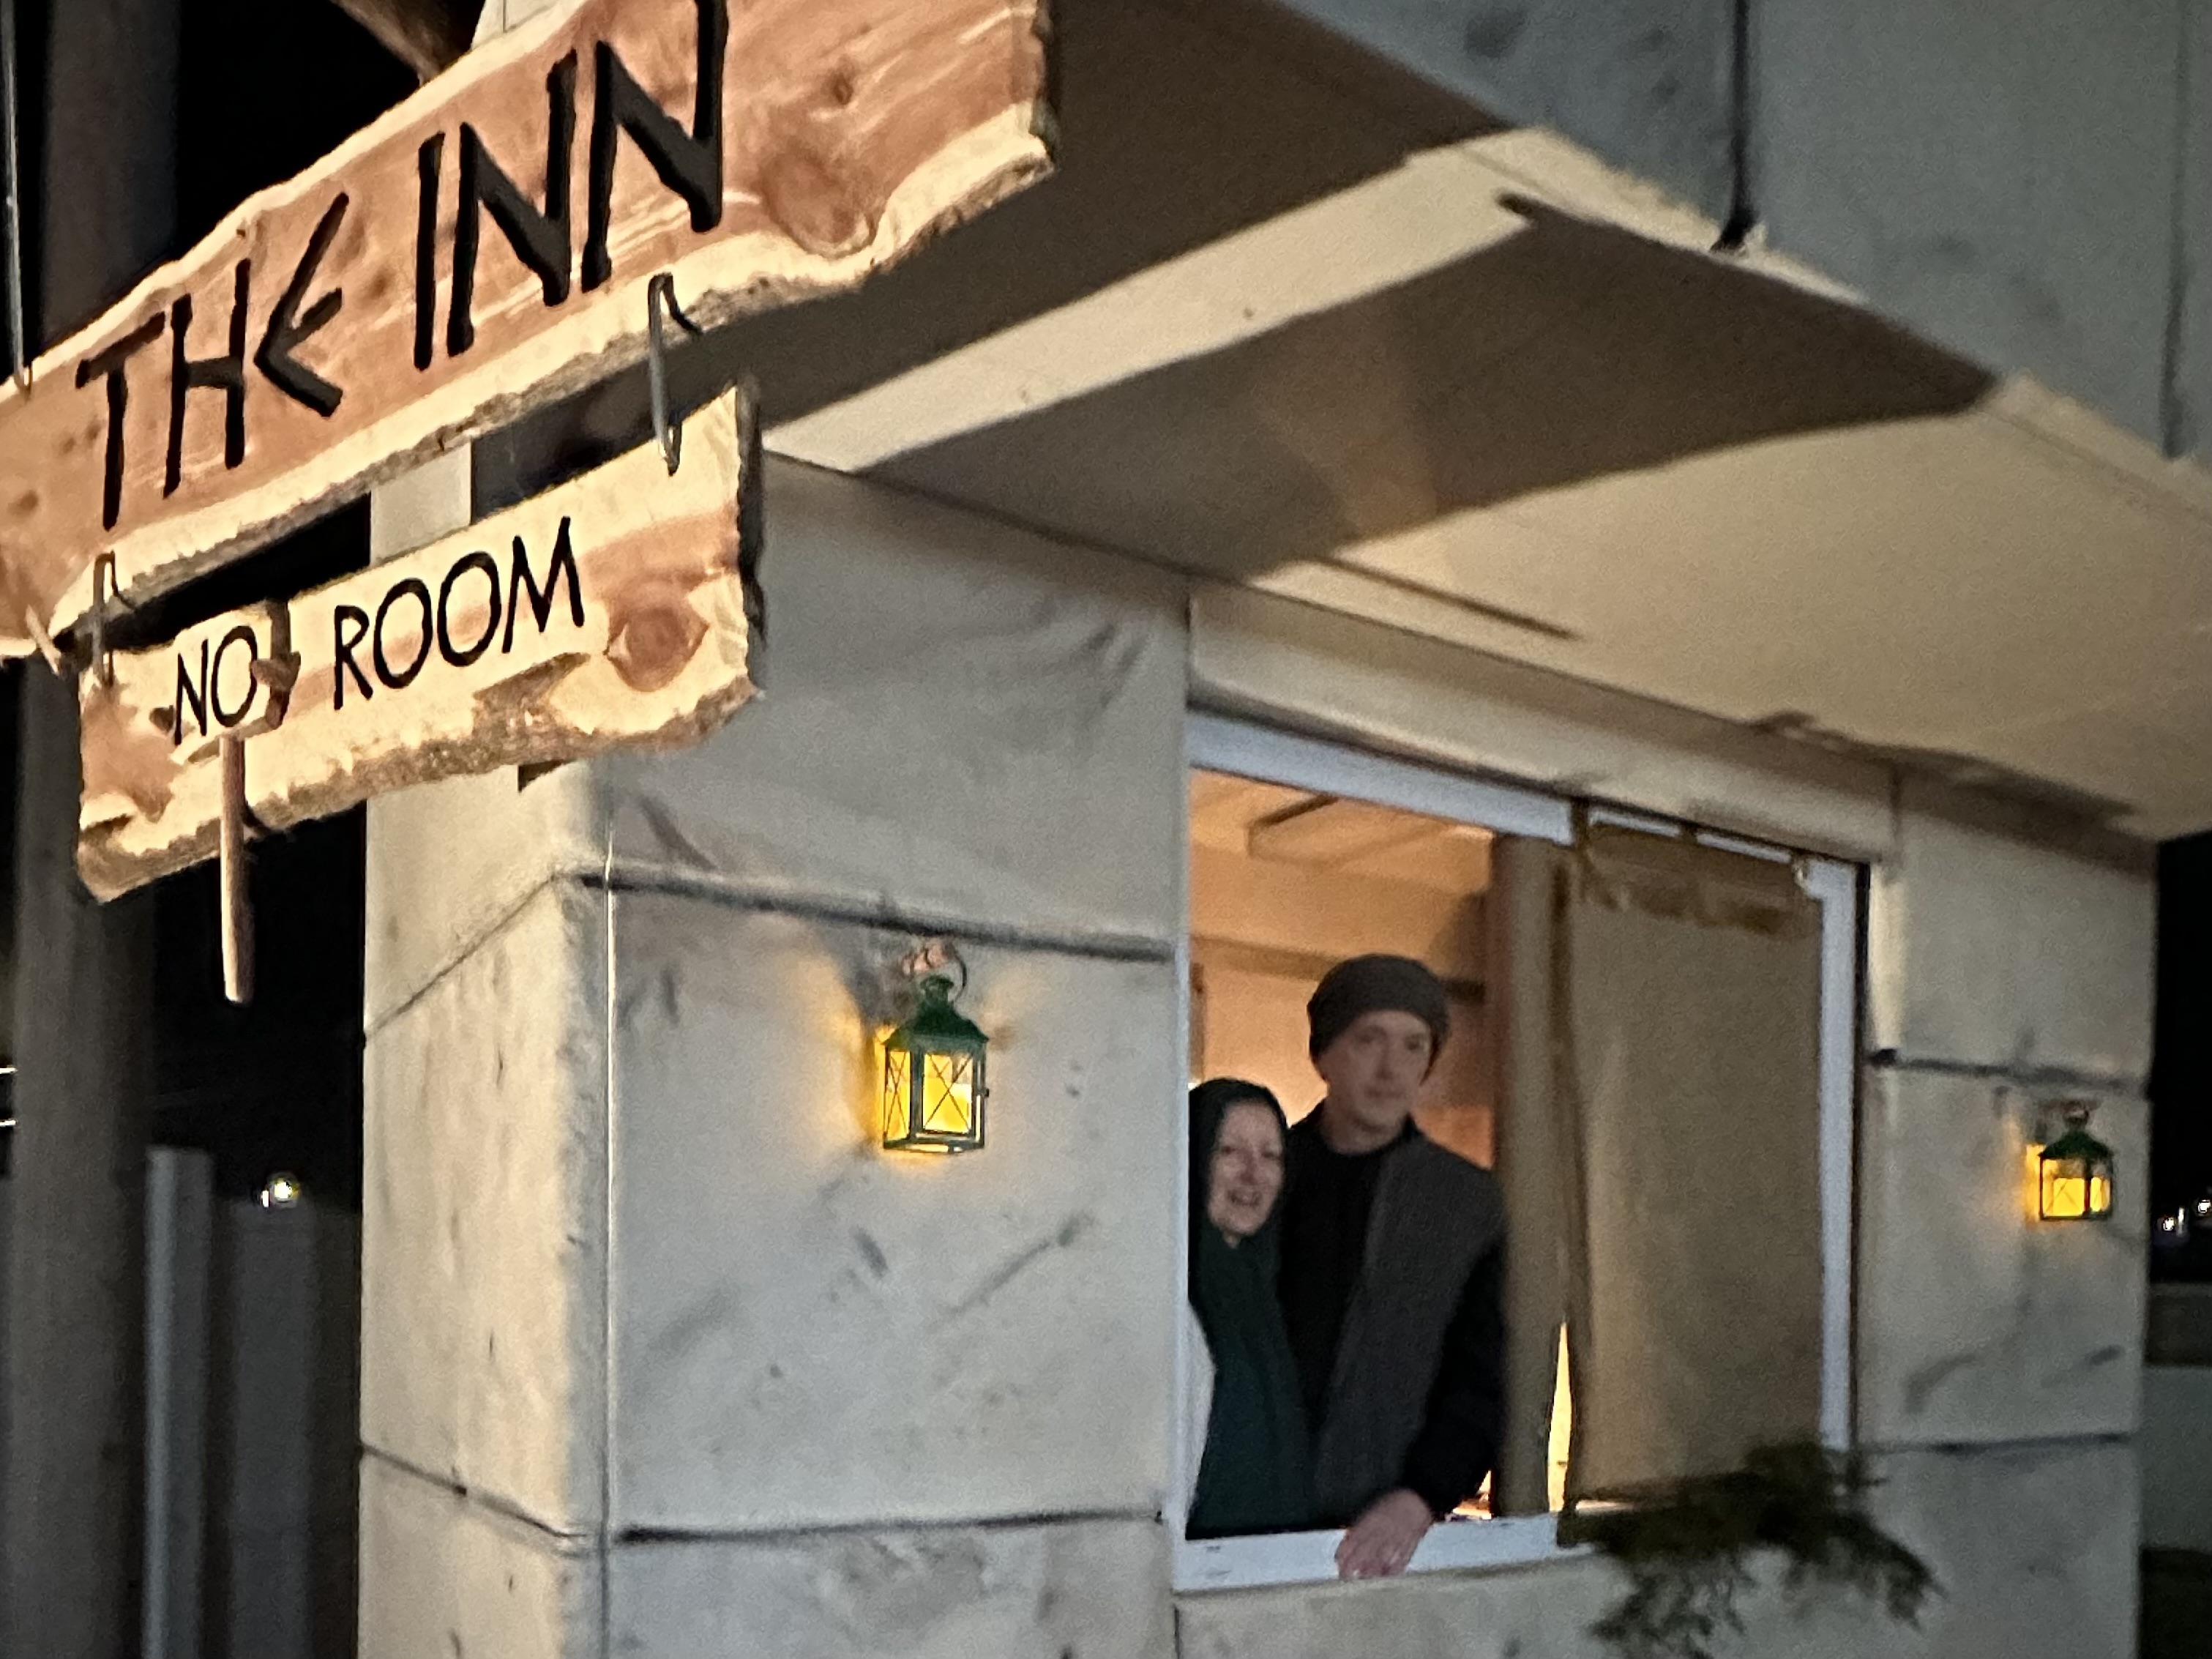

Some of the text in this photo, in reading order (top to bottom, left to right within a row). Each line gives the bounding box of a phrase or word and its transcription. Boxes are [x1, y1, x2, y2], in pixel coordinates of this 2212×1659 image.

[75, 0, 729, 530] THE INN
[173, 515, 585, 746] NO ROOM
